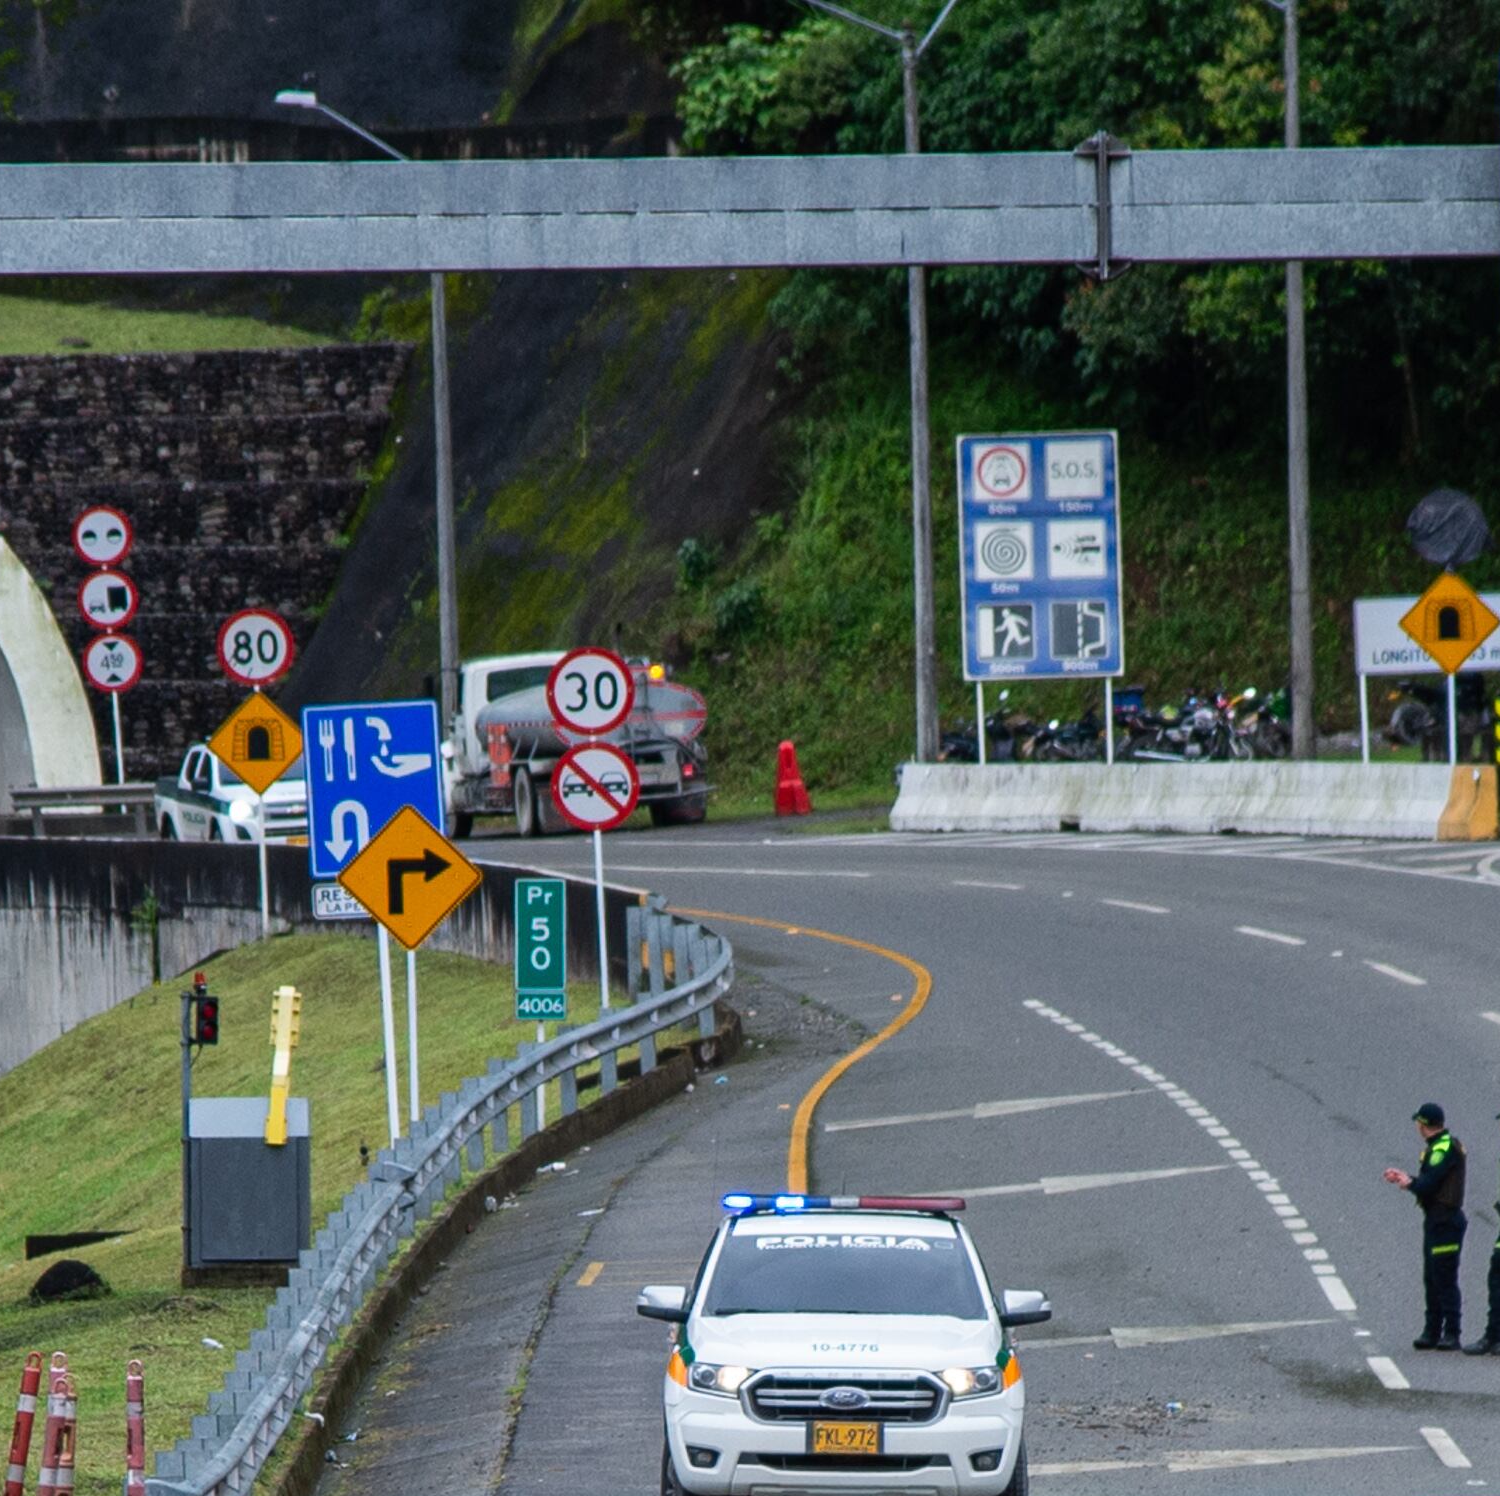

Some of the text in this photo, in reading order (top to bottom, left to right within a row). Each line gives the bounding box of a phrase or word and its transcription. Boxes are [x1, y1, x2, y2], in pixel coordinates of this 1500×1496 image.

[1051, 462, 1099, 480] S.O.S.
[233, 629, 279, 665] 80
[1372, 648, 1431, 665] LONGITU
[564, 671, 618, 713] 30
[526, 885, 553, 905] Pr
[518, 997, 563, 1014] 4006
[756, 1235, 931, 1251] POLICIA
[811, 1343, 879, 1353] 10-4776
